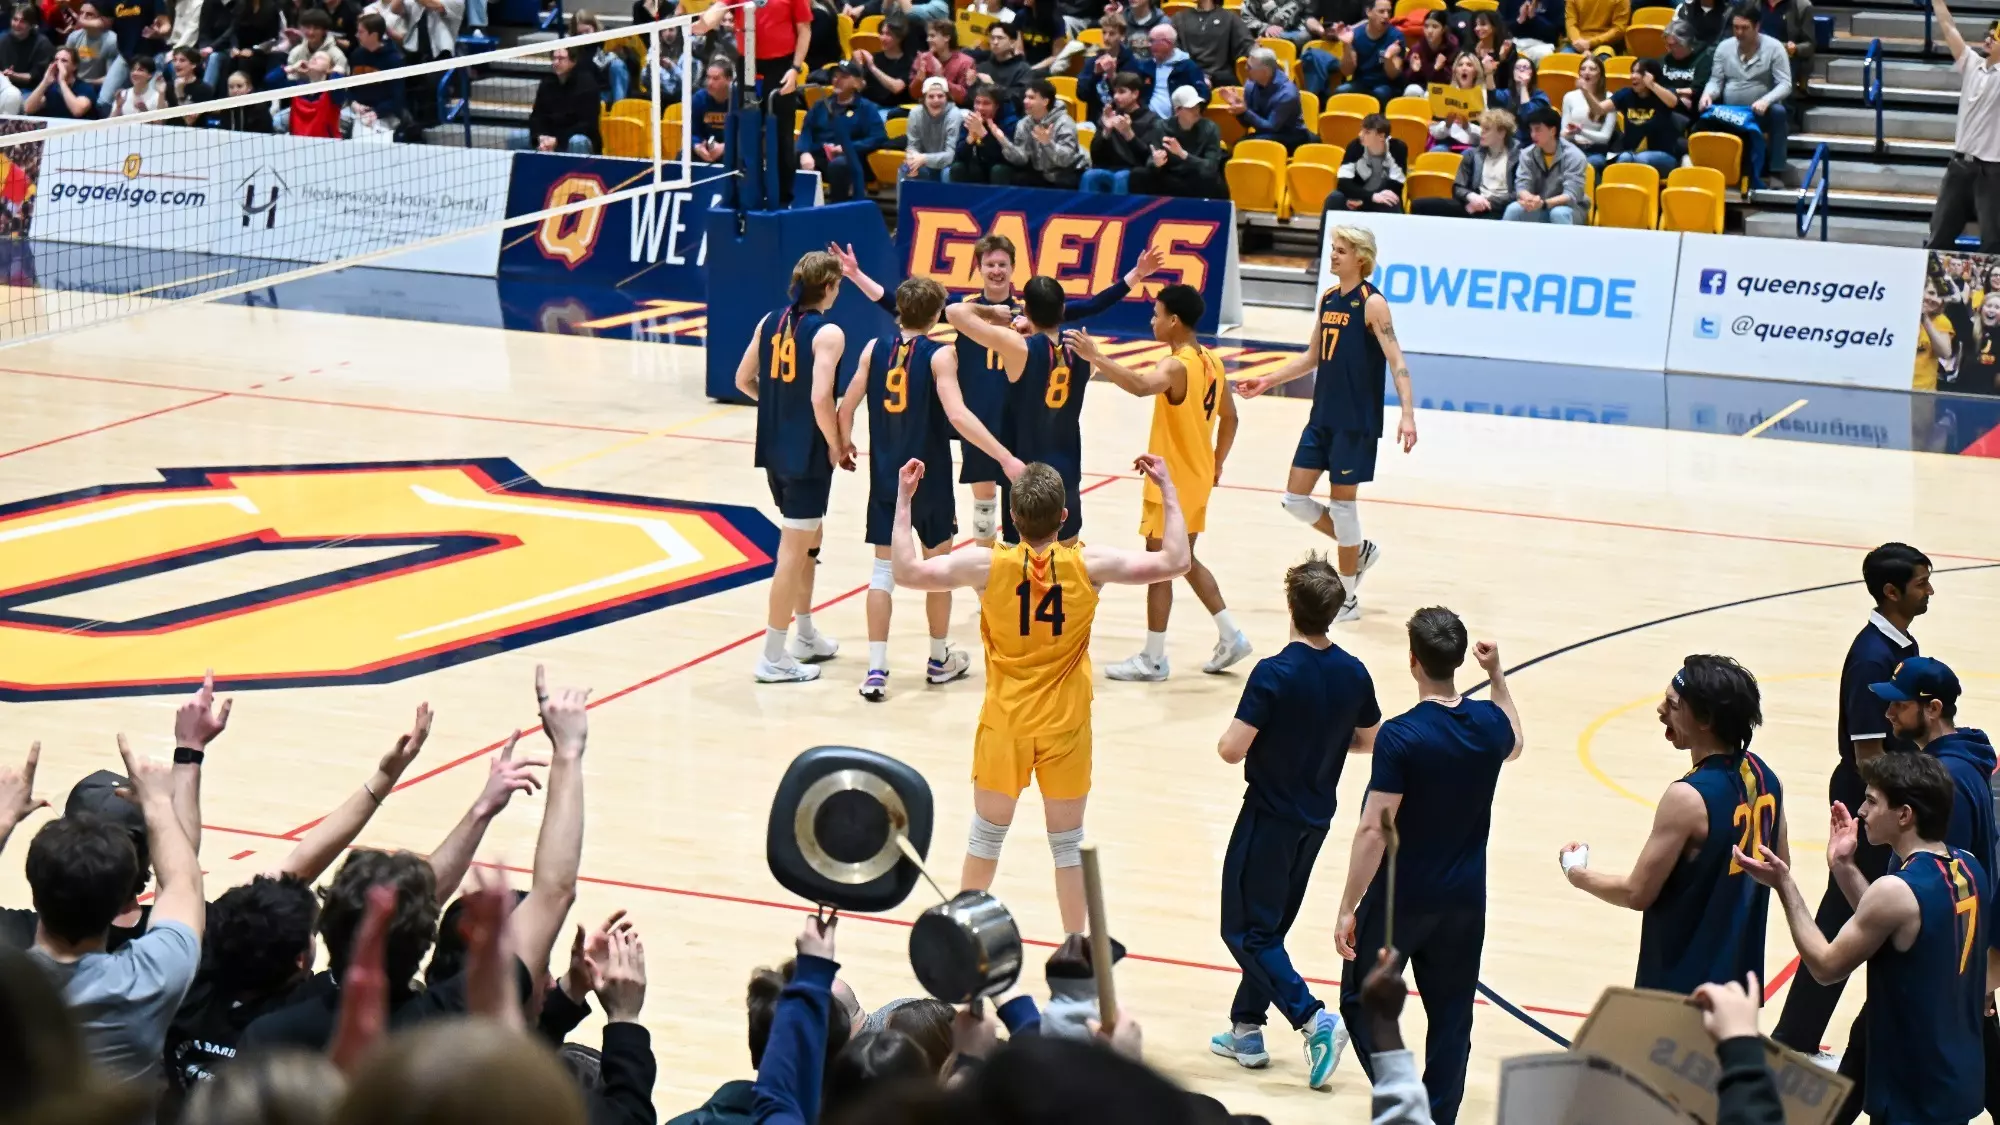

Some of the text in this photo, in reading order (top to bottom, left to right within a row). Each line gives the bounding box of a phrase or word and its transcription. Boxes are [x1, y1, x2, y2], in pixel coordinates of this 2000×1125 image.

[50, 183, 206, 208] gogaelsgo.com
[630, 191, 693, 265] WE
[907, 206, 1221, 303] GAELS
[1373, 261, 1637, 319] OWERADE
[1736, 275, 1887, 303] queensgaels
[1321, 327, 1340, 361] 17
[1731, 314, 1895, 349] @queensgaels
[770, 333, 796, 383] 19
[884, 366, 907, 413] 9
[1045, 366, 1070, 409] 8
[1203, 377, 1217, 421] 4
[1015, 579, 1066, 637] 14
[1728, 793, 1776, 875] 20
[1955, 894, 1977, 975] 7
